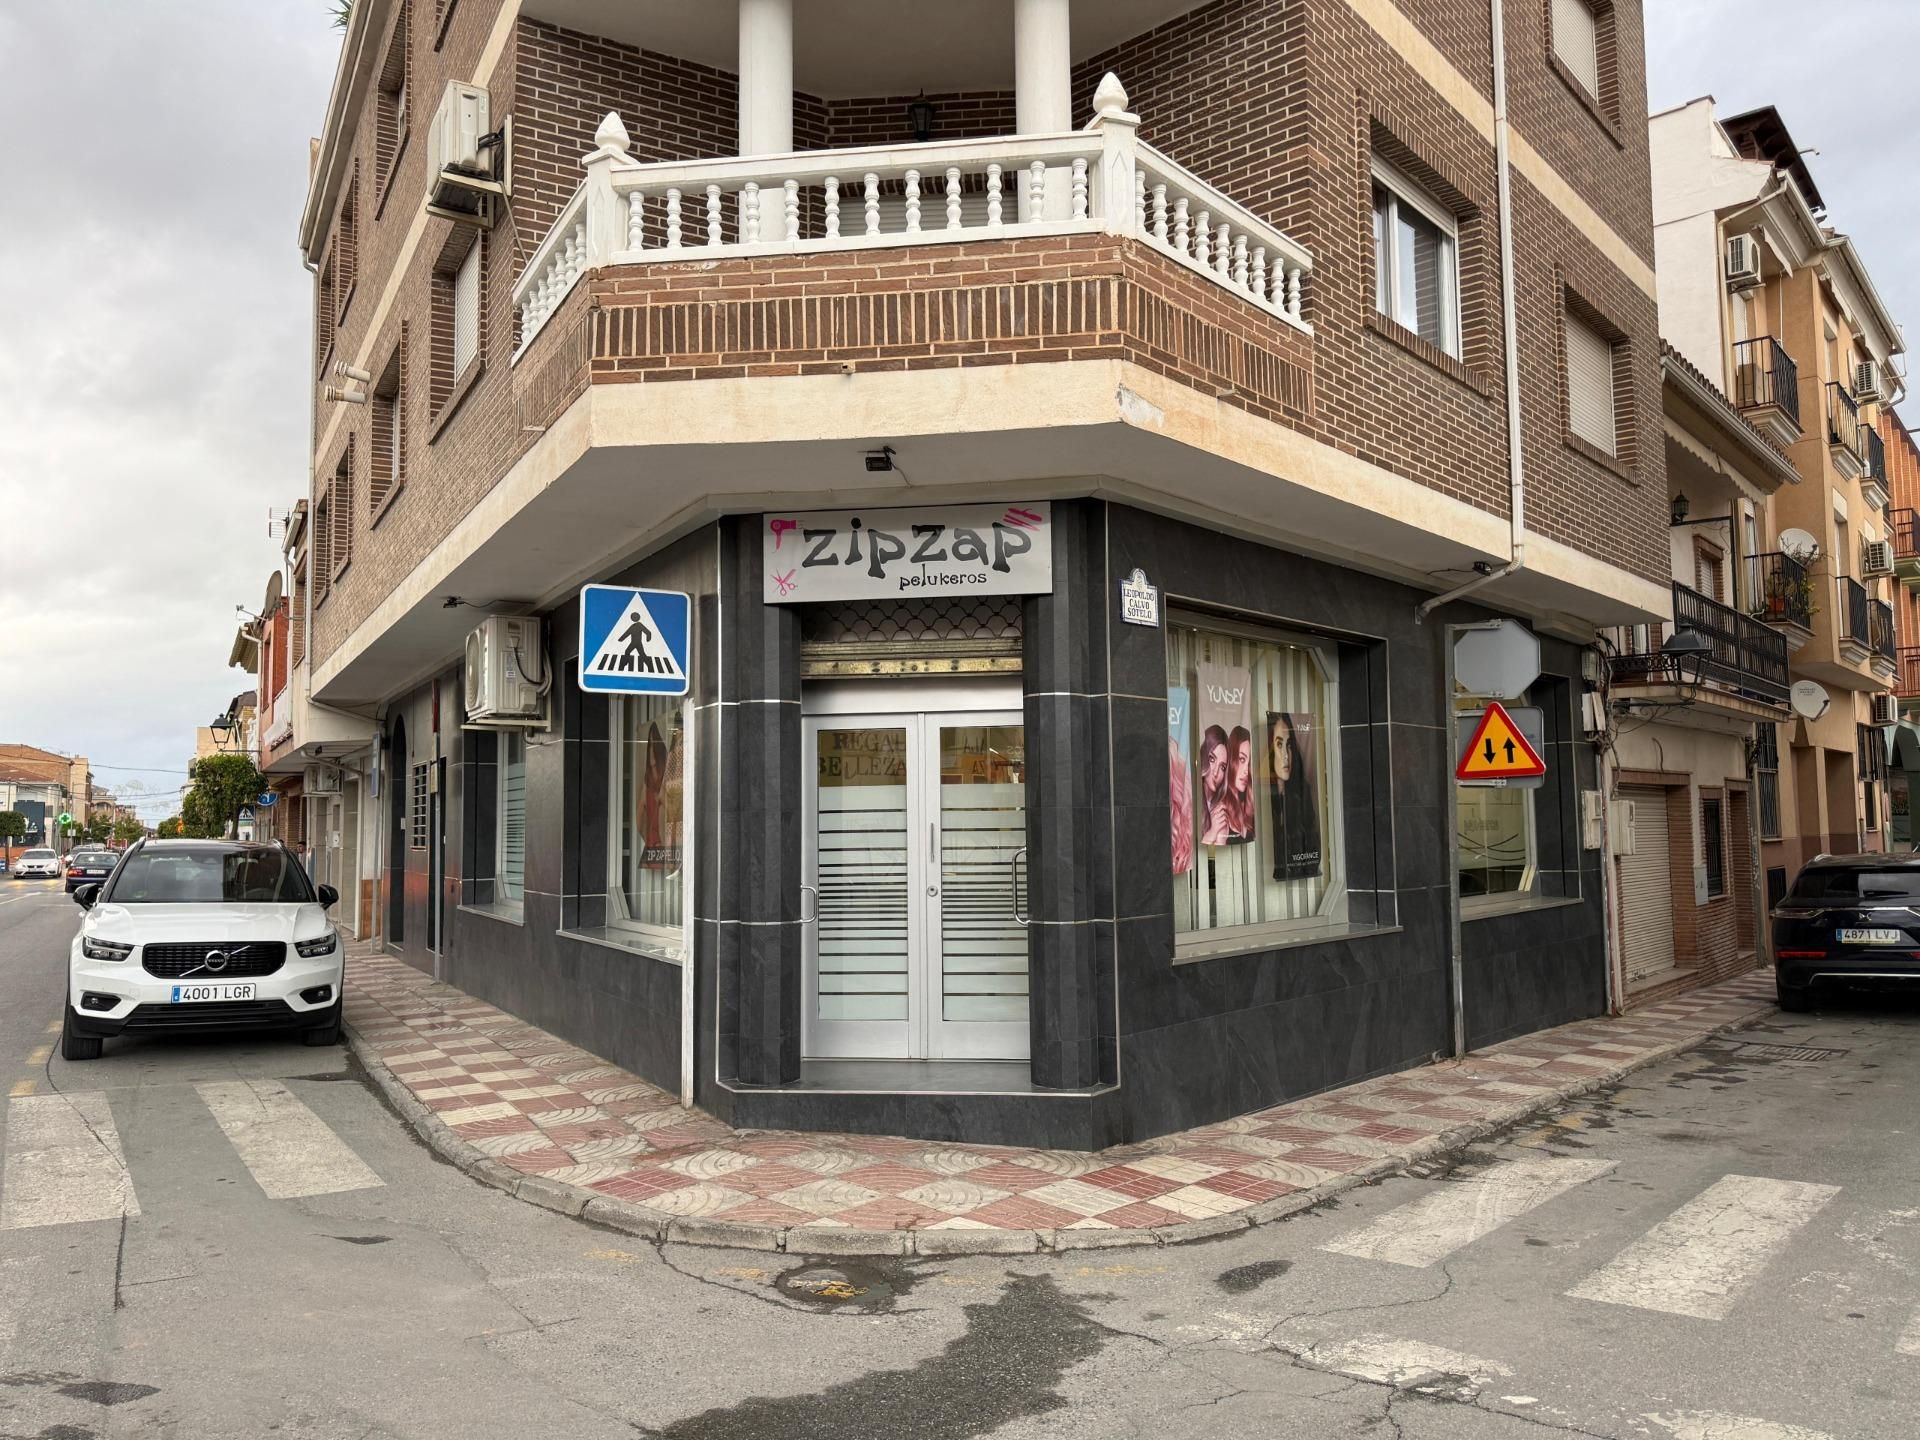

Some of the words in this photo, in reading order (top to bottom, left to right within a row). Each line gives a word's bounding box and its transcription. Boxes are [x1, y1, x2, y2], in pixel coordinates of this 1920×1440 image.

[899, 563, 987, 591] pelukeros
[1124, 589, 1155, 602] LEOPOLDO
[1129, 599, 1150, 610] CALVO
[1127, 607, 1152, 619] SOTELO
[1206, 684, 1244, 705] YUNSEY
[1844, 929, 1871, 939] 4871
[1876, 929, 1898, 940] LVJ
[183, 987, 218, 1000] 4001
[224, 986, 251, 999] LGR
